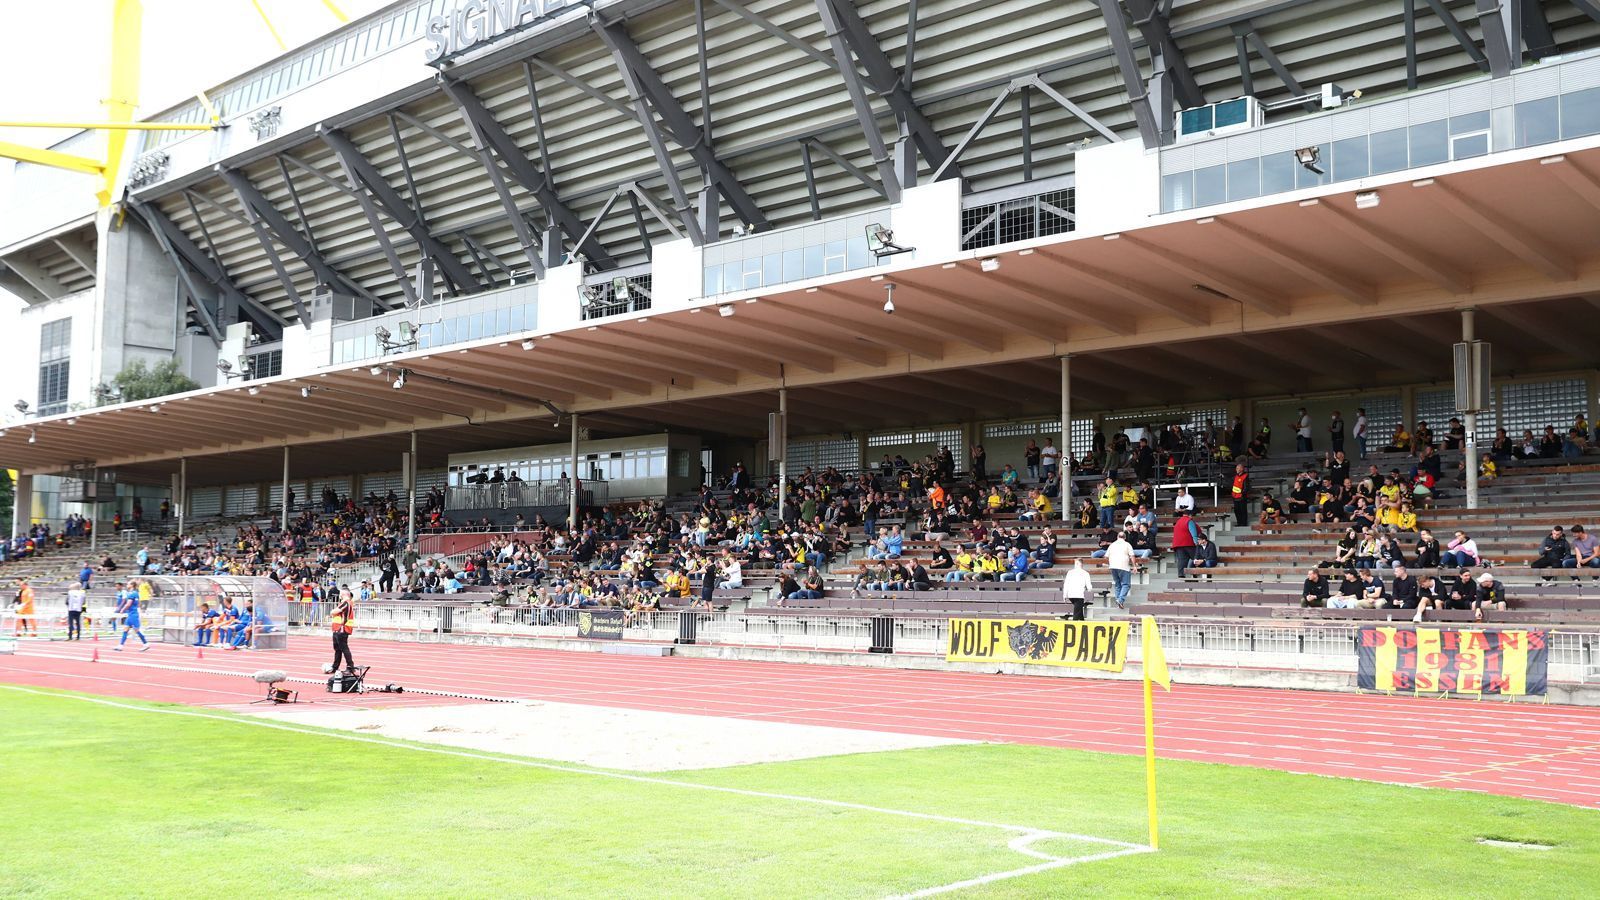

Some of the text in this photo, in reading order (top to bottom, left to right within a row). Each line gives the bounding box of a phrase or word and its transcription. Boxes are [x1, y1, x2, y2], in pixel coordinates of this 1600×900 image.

[424, 0, 567, 62] SIGNA
[1465, 432, 1475, 443] H
[1061, 456, 1069, 466] G
[950, 619, 1121, 665] WOLF PACK
[1360, 628, 1546, 651] DO-FANS
[1401, 651, 1501, 672] 1981
[1391, 671, 1512, 692] ESSEN
